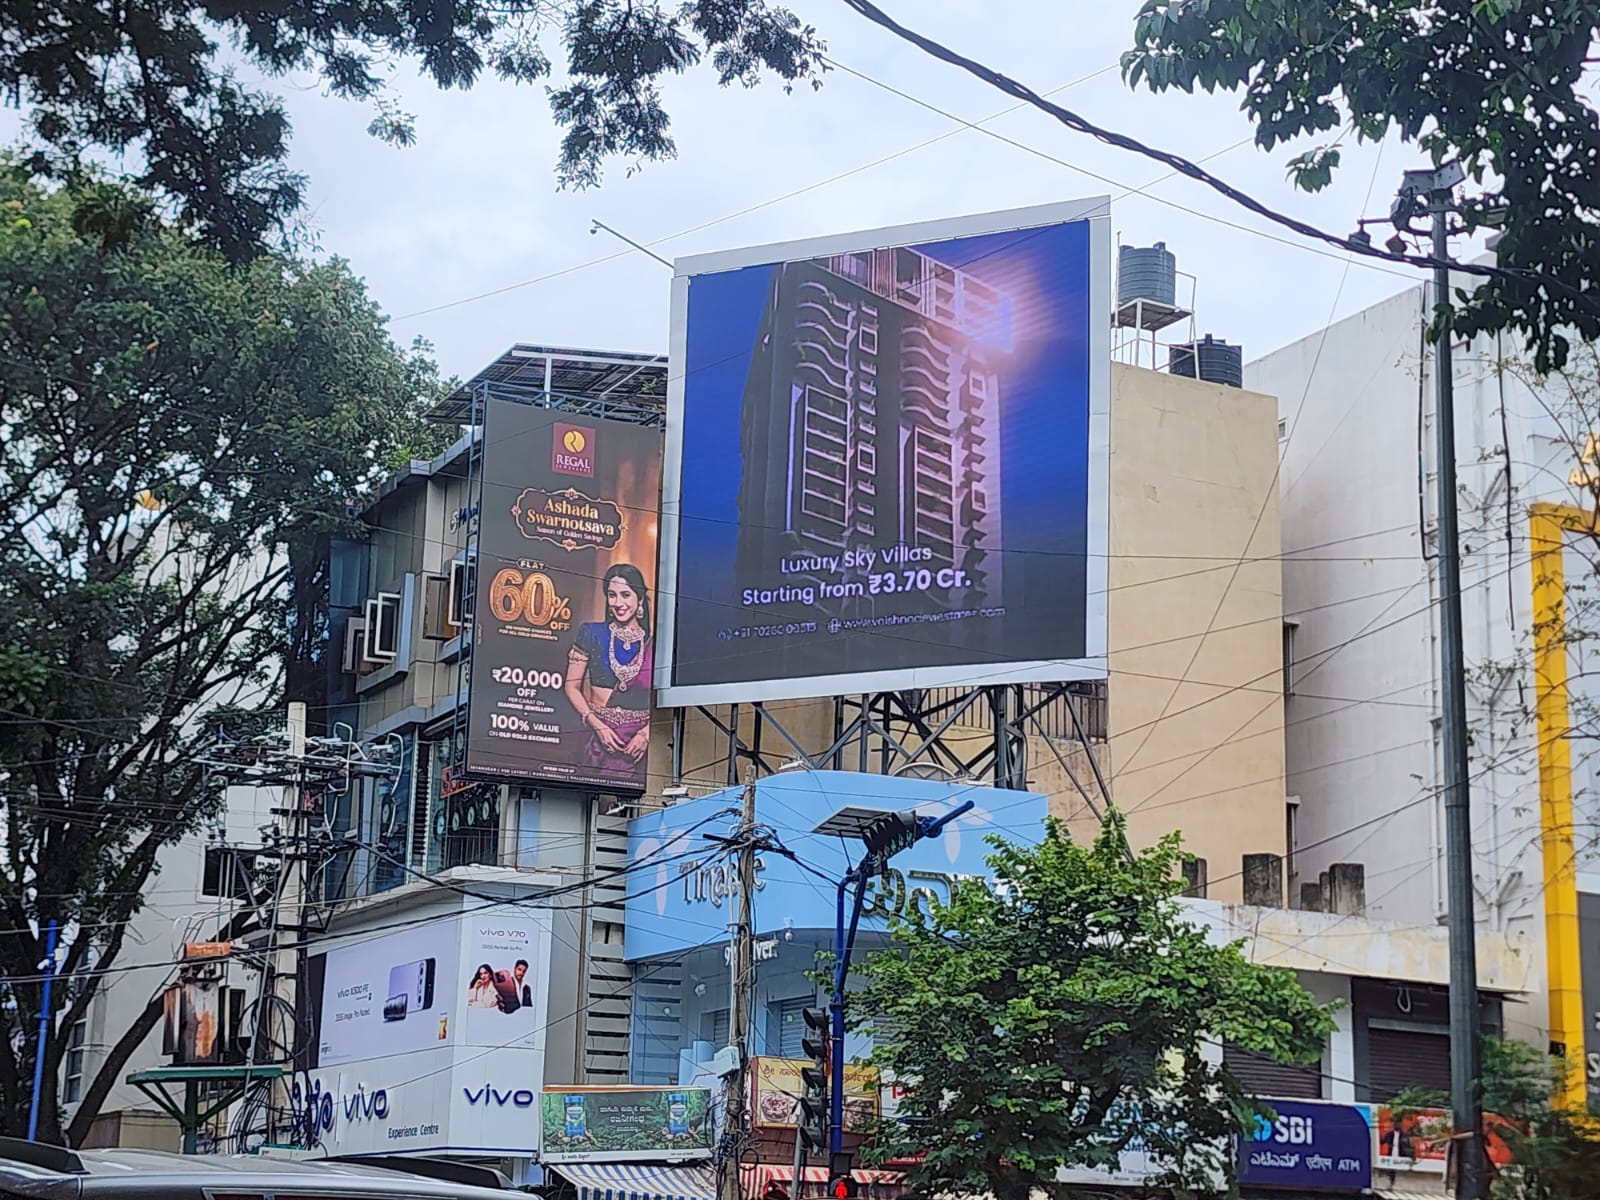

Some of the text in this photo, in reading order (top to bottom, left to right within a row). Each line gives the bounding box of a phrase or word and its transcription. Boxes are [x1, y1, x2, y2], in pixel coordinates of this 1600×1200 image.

[556, 454, 591, 469] REGAL
[544, 498, 599, 519] Ashada
[527, 509, 615, 536] Swarnotsava
[520, 560, 545, 570] FLAT
[781, 545, 932, 573] Luxury Sky Villas
[742, 567, 972, 605] Starting from ₹3.70 Cr.
[489, 568, 572, 626] 60%
[550, 621, 571, 631] OFF
[492, 666, 563, 690] ₹20,000
[517, 687, 537, 698] OFF
[490, 714, 560, 733] 100% VALUE
[480, 928, 526, 938] vivo V70
[343, 1083, 388, 1120] vivo
[464, 1083, 534, 1106] vivo
[388, 1124, 439, 1139] Experience Centre
[1274, 1115, 1313, 1144] SBI
[1338, 1159, 1360, 1171] ATM
